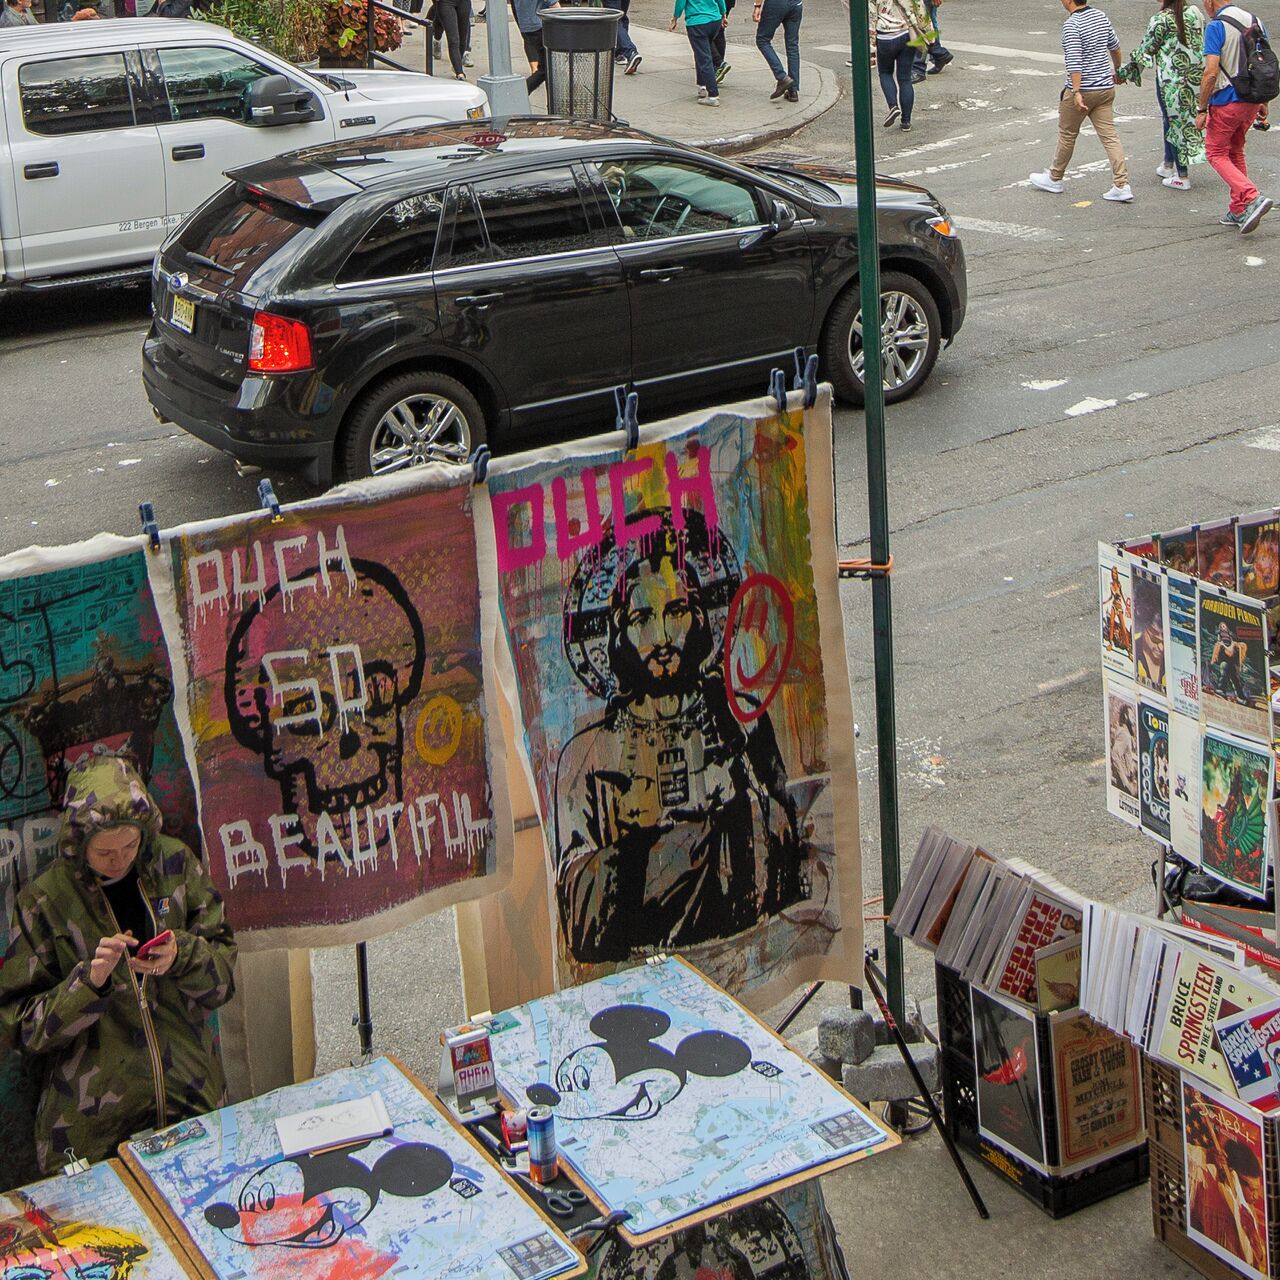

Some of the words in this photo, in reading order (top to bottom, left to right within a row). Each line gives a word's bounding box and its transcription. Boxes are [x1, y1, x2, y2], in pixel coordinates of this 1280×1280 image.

[119, 221, 132, 232] 222
[134, 219, 158, 231] Bergen
[220, 348, 245, 359] LIMITED
[491, 445, 718, 572] OUCH
[188, 525, 358, 608] OUCH
[1202, 598, 1236, 619] FORBIDDEN
[261, 643, 367, 730] SO
[220, 791, 492, 885] BEAUTIFUL
[1213, 975, 1223, 995] BAND
[1170, 977, 1191, 1028] BRUCE
[1178, 962, 1216, 1064] SPRINGSTEEN
[1208, 995, 1220, 1023] STREET
[1201, 1030, 1210, 1047] THE
[1222, 1020, 1255, 1055] BRUCE
[1197, 1048, 1206, 1064] AND
